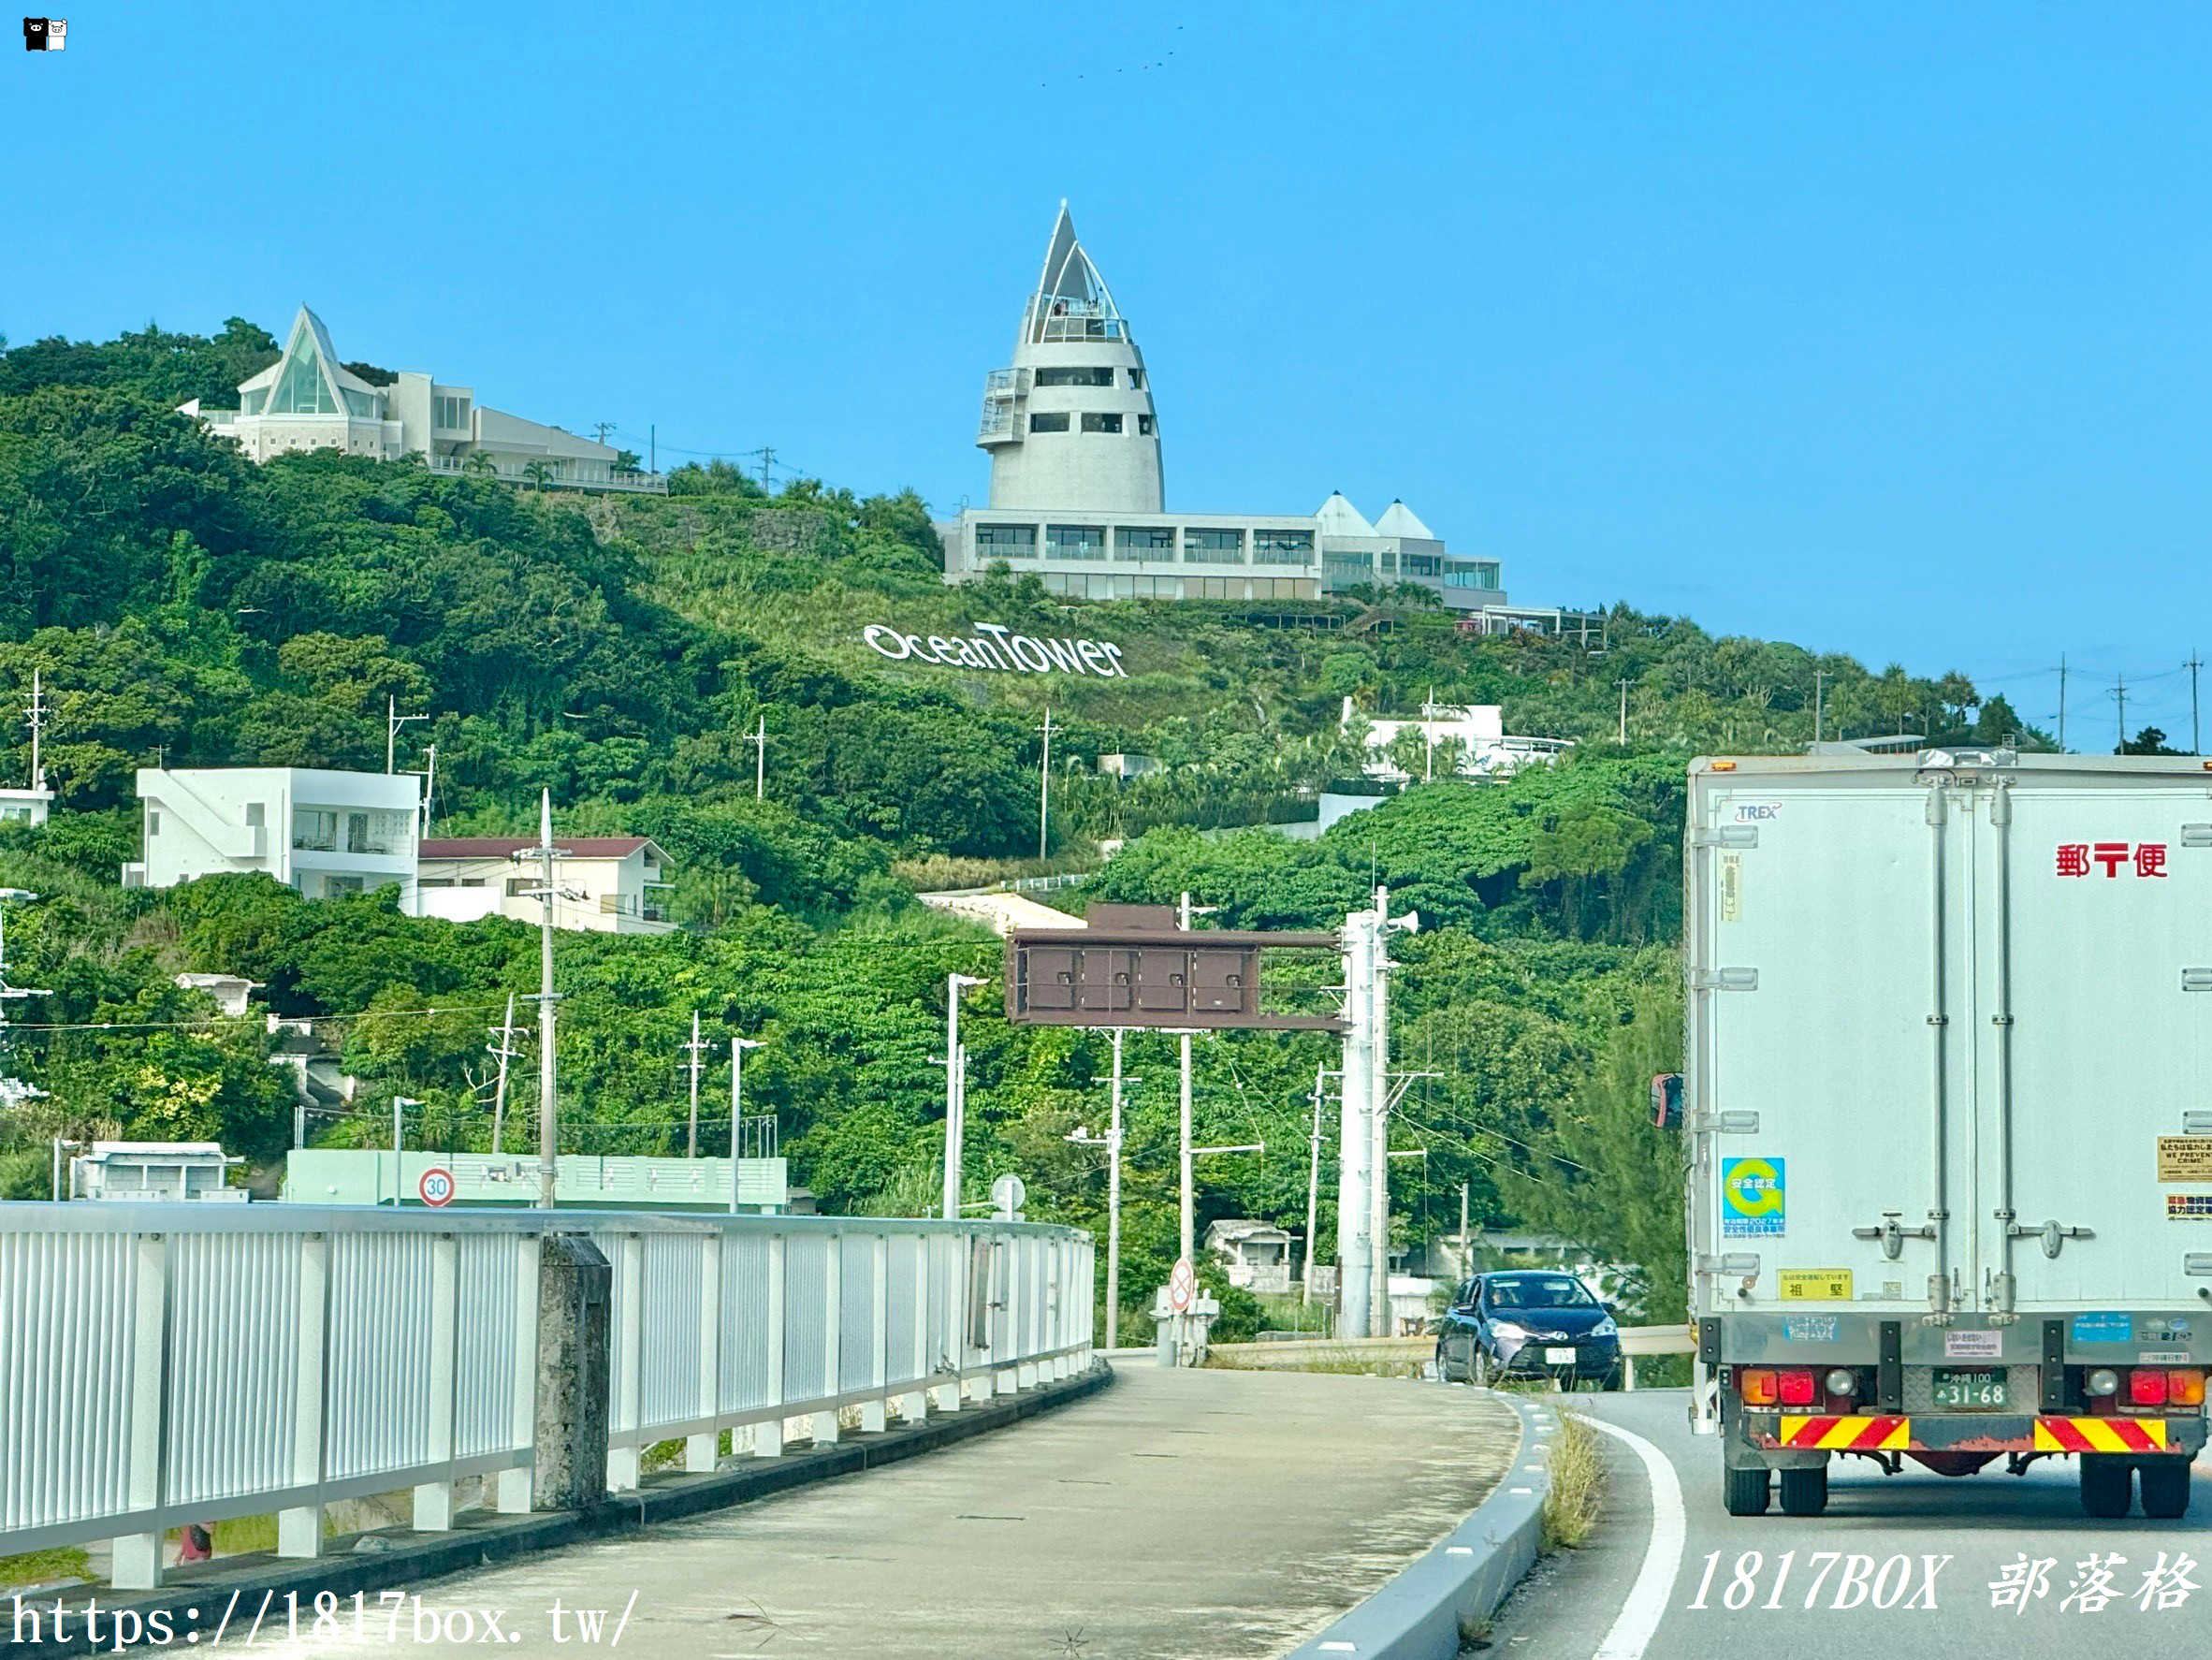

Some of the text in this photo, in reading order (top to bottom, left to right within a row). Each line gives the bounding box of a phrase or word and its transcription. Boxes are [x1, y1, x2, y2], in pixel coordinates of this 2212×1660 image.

[864, 622, 1128, 677] OceanTower
[427, 1178, 446, 1196] 30
[1731, 1178, 1776, 1189] 安全認定
[1949, 1385, 2003, 1404] 31-68
